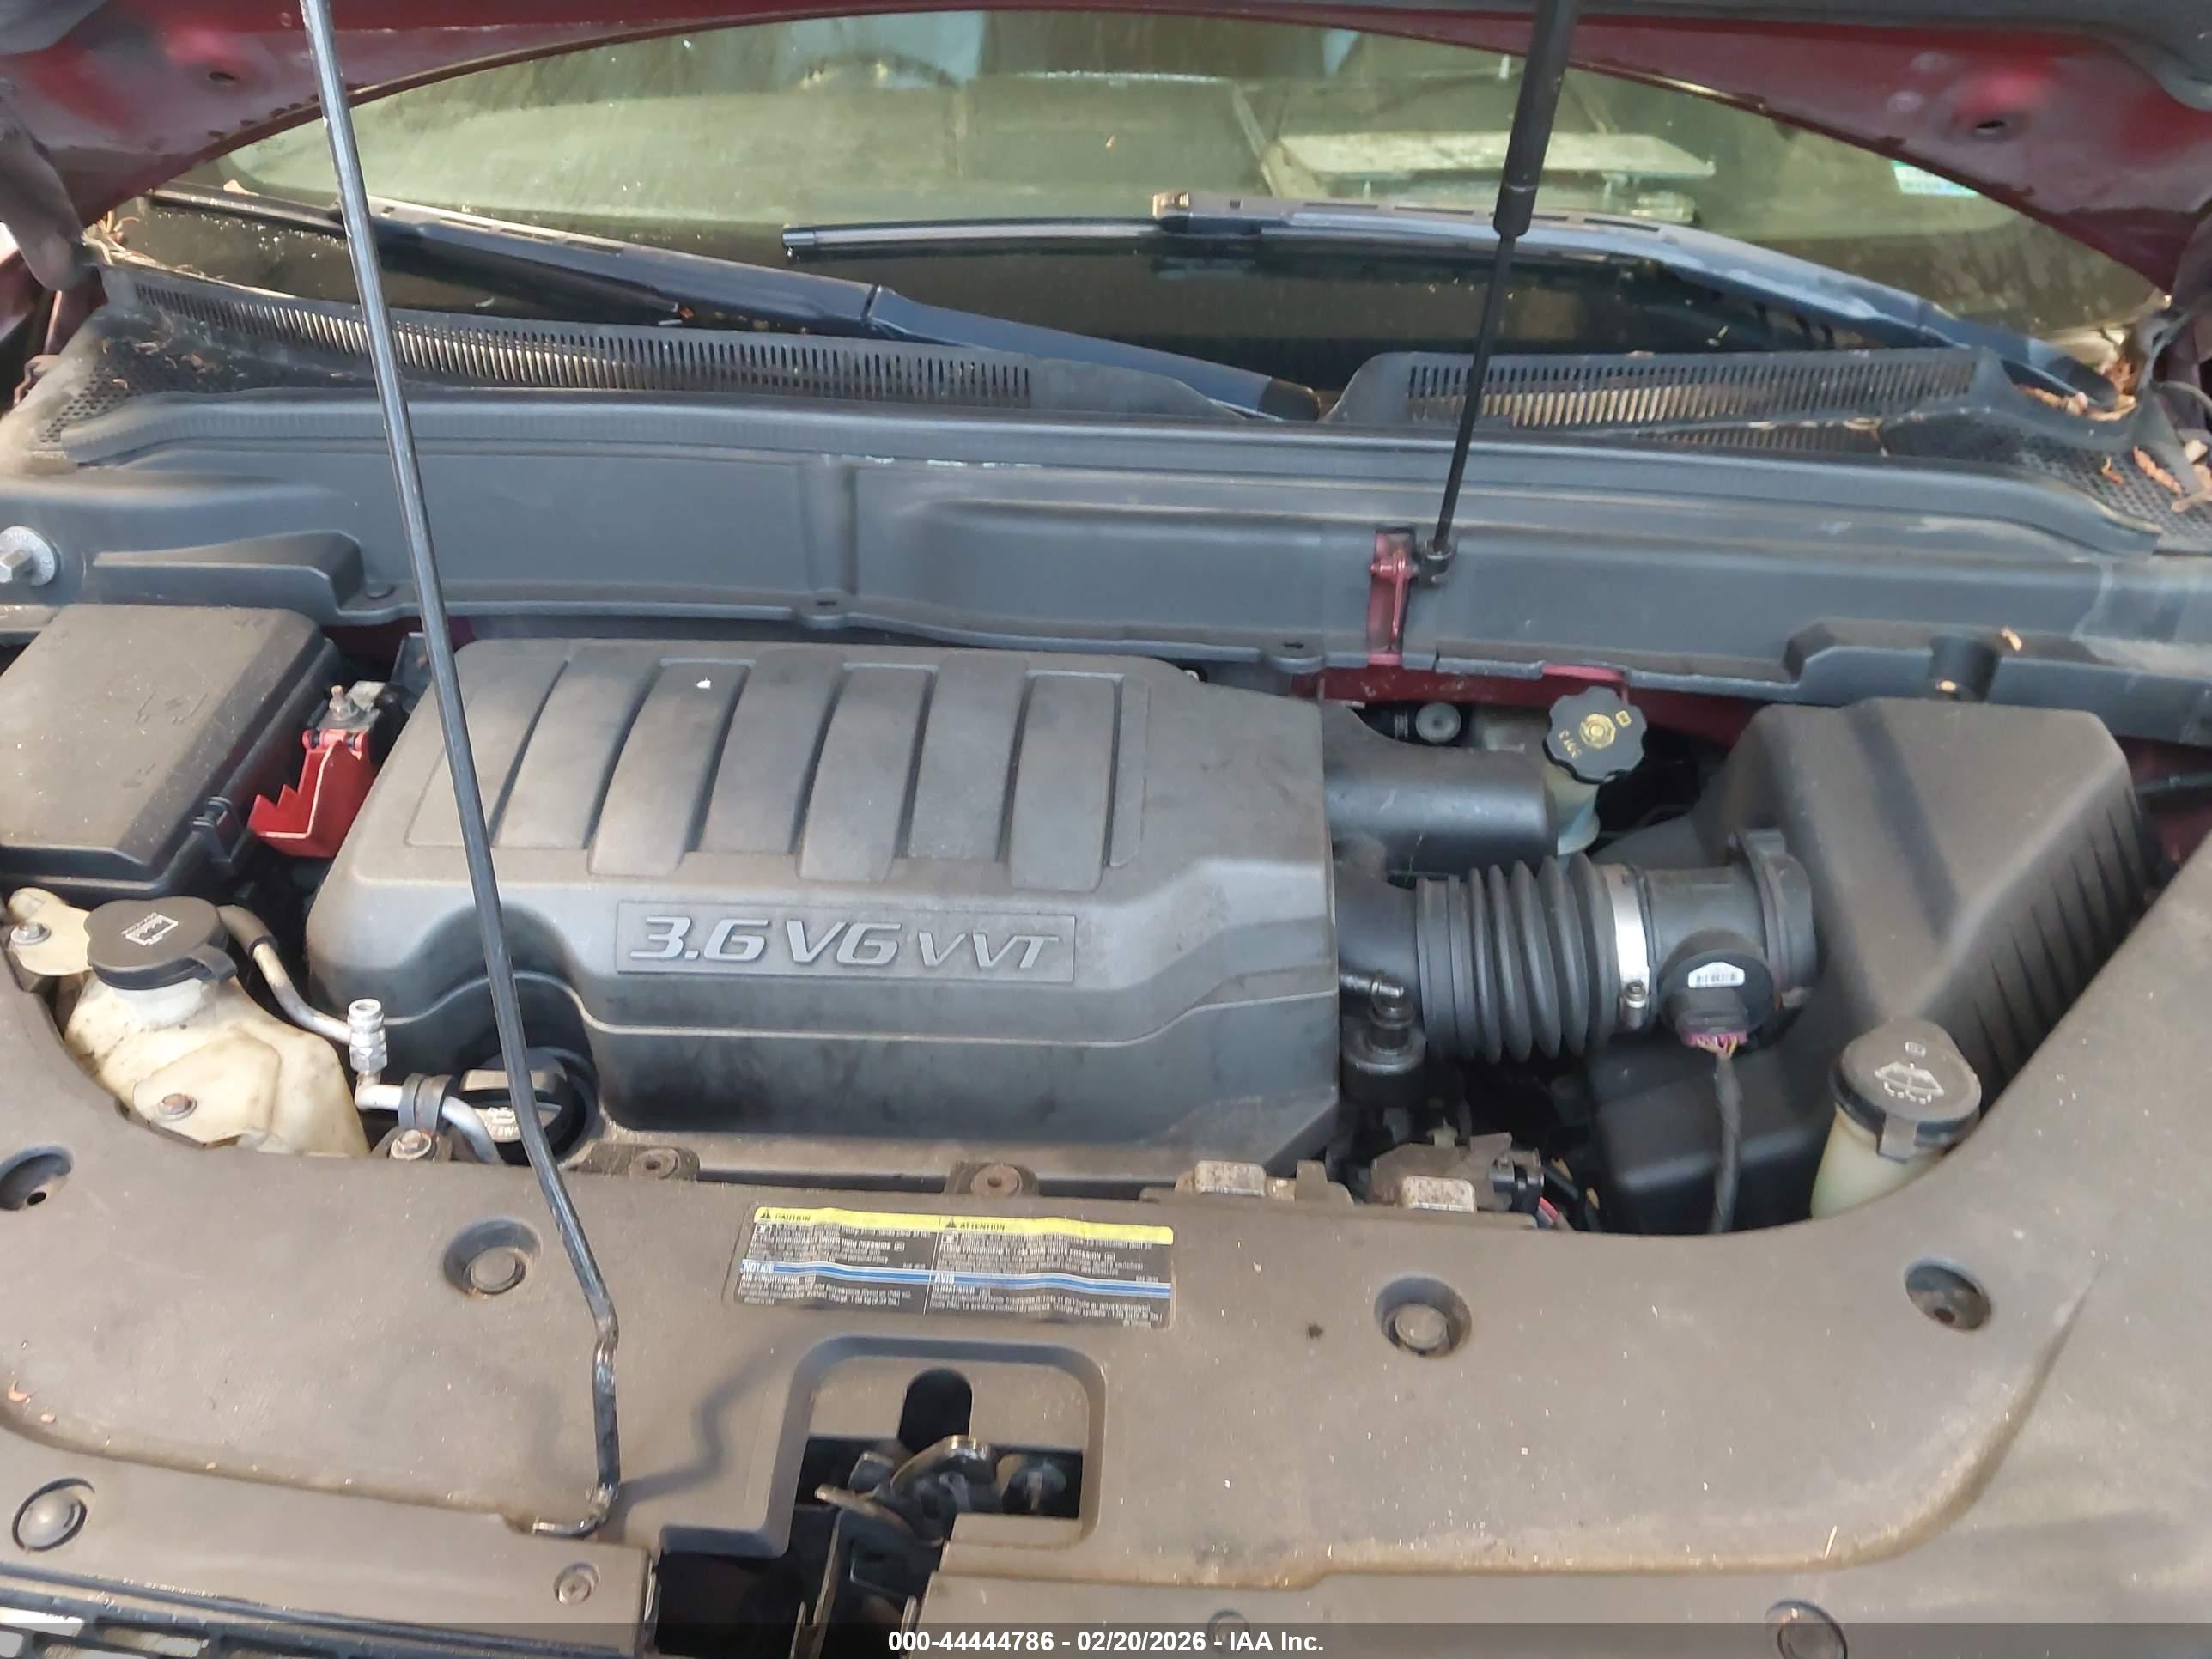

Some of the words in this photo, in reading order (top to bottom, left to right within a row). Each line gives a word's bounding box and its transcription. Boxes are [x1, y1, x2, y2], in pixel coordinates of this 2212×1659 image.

[629, 915, 770, 962] 3.6
[785, 919, 902, 966] V6
[918, 932, 1060, 969] VVT
[960, 1222, 1005, 1231] ATTENTION
[743, 1261, 775, 1273] NOTICE
[934, 1273, 955, 1285] AVIS
